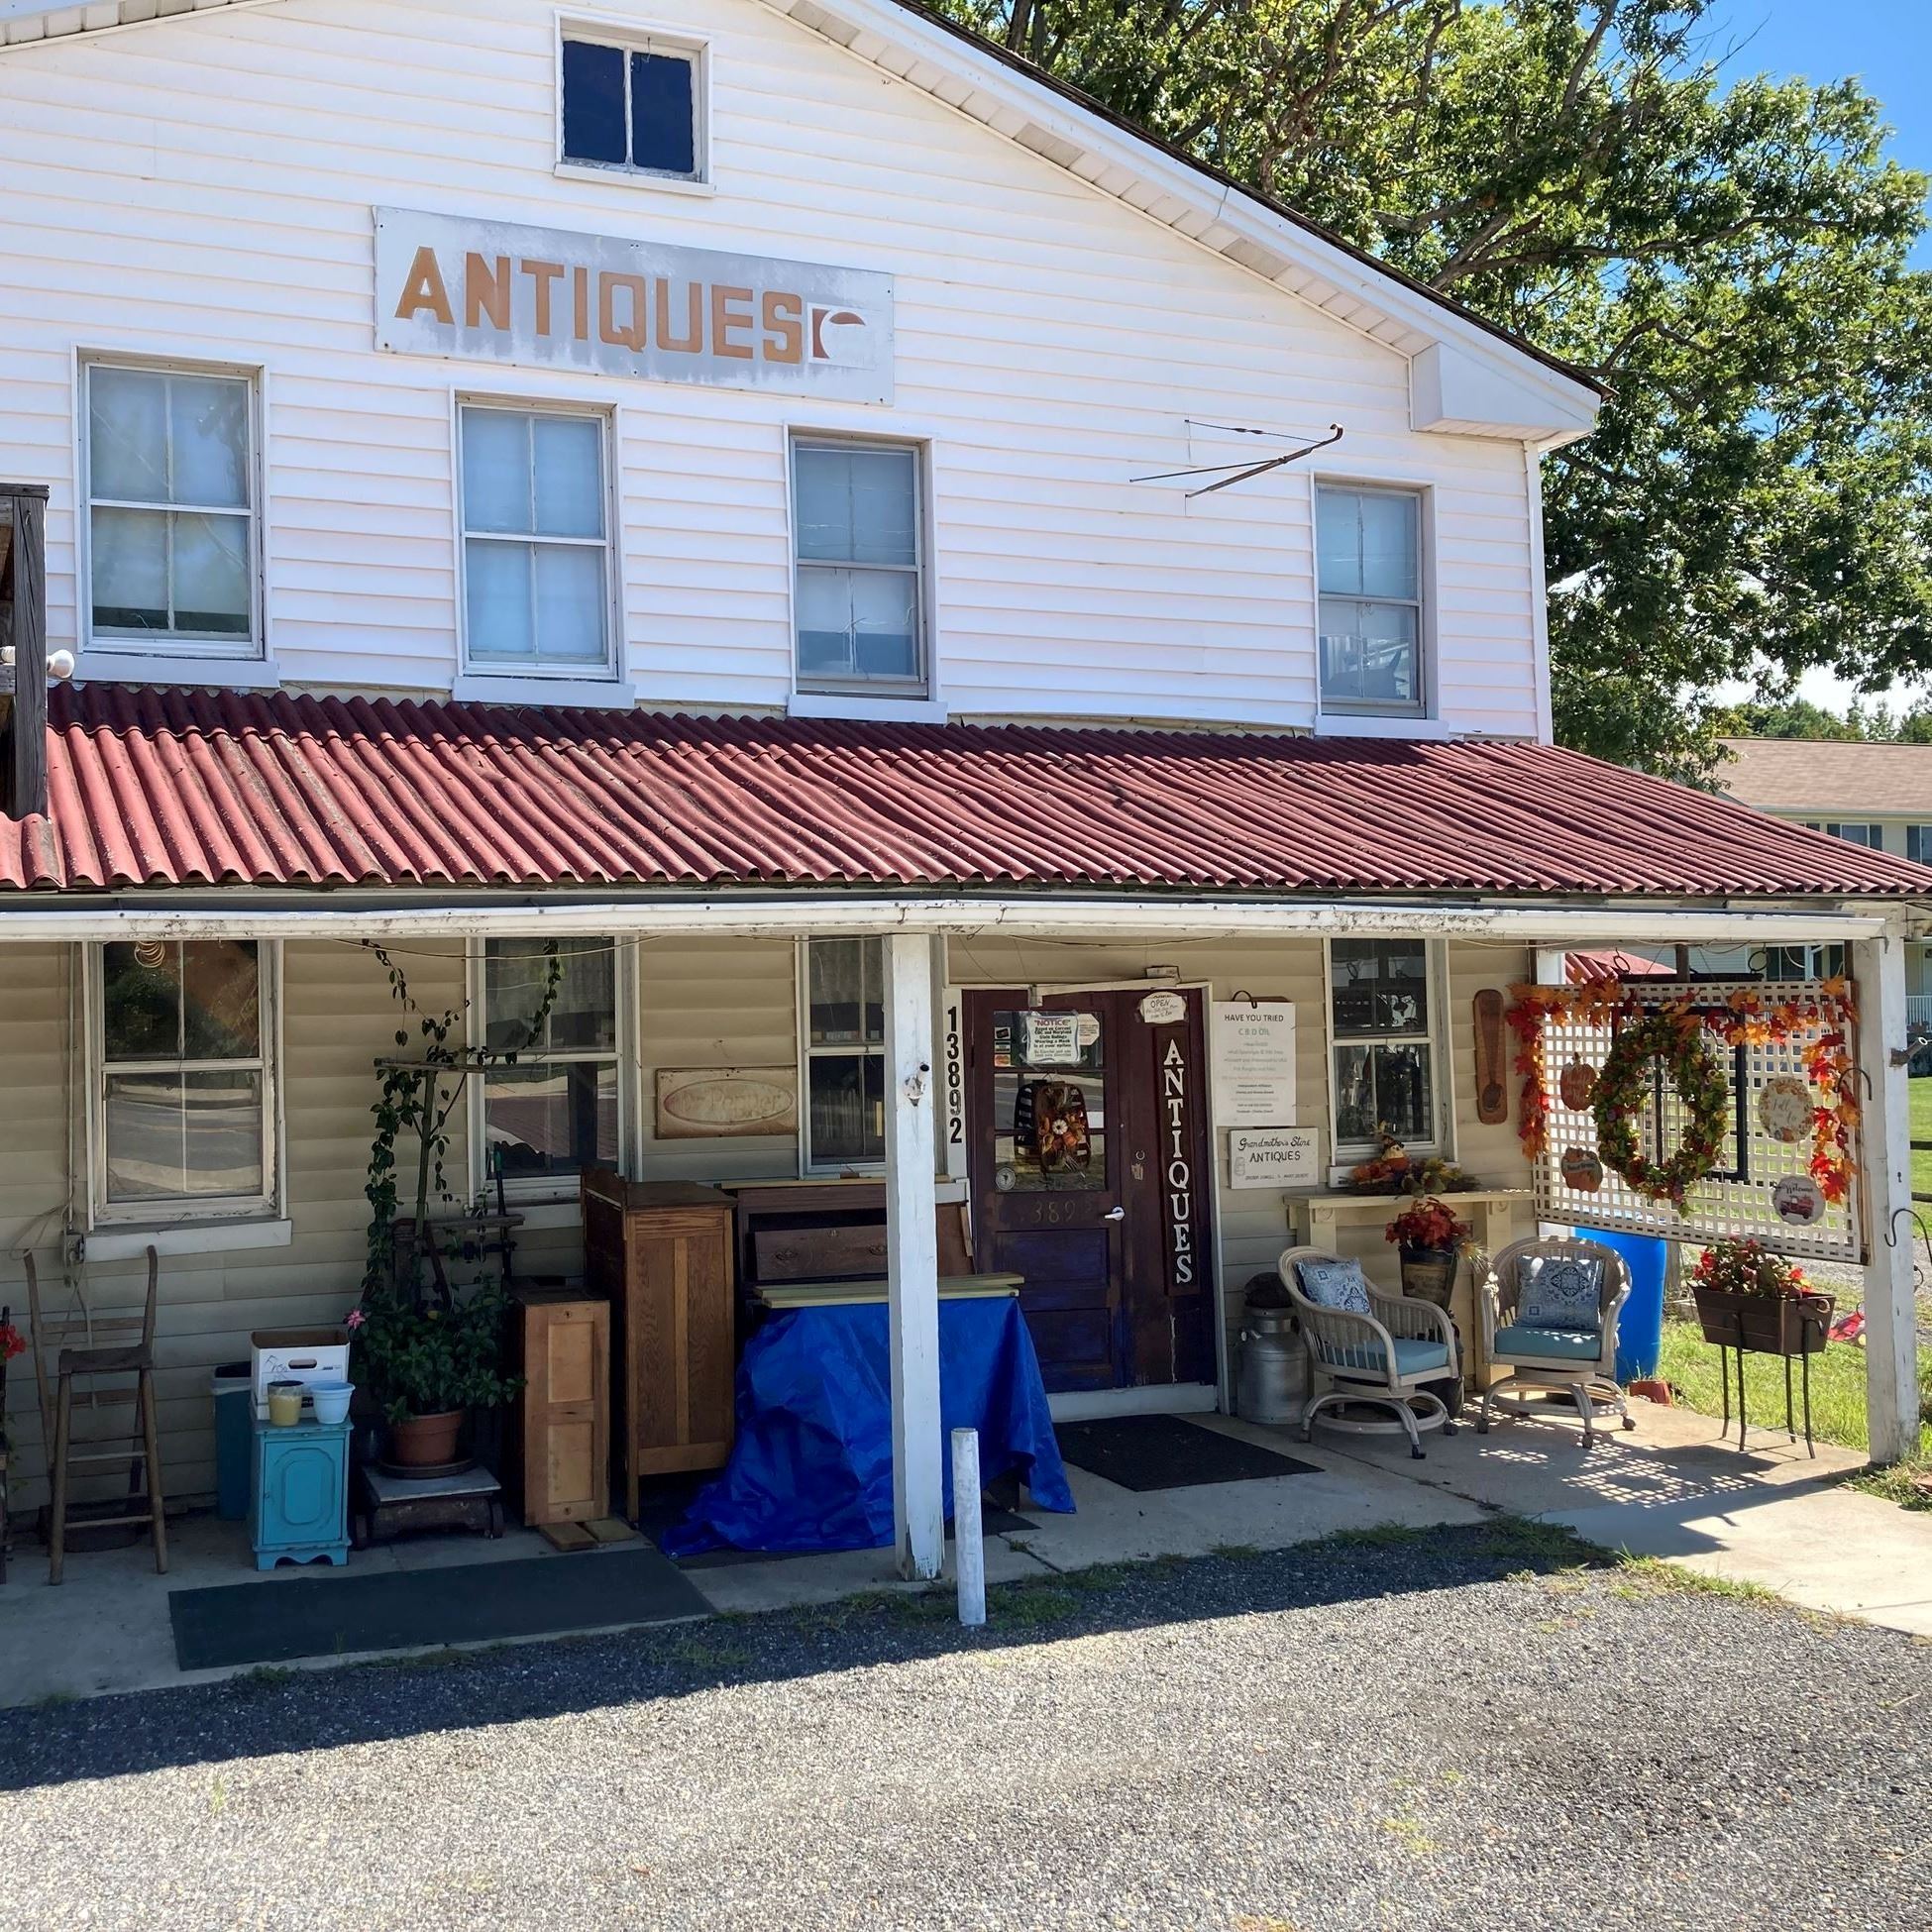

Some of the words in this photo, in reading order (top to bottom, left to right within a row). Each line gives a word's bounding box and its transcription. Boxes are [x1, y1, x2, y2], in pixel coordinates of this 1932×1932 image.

[394, 246, 803, 365] ANTIQUES
[1150, 999, 1171, 1009] OPEN
[946, 1006, 963, 1144] 13892
[1162, 1038, 1193, 1284] ANTIQUES
[1249, 1150, 1301, 1163] ANTIQUES
[1290, 1135, 1312, 1147] Store
